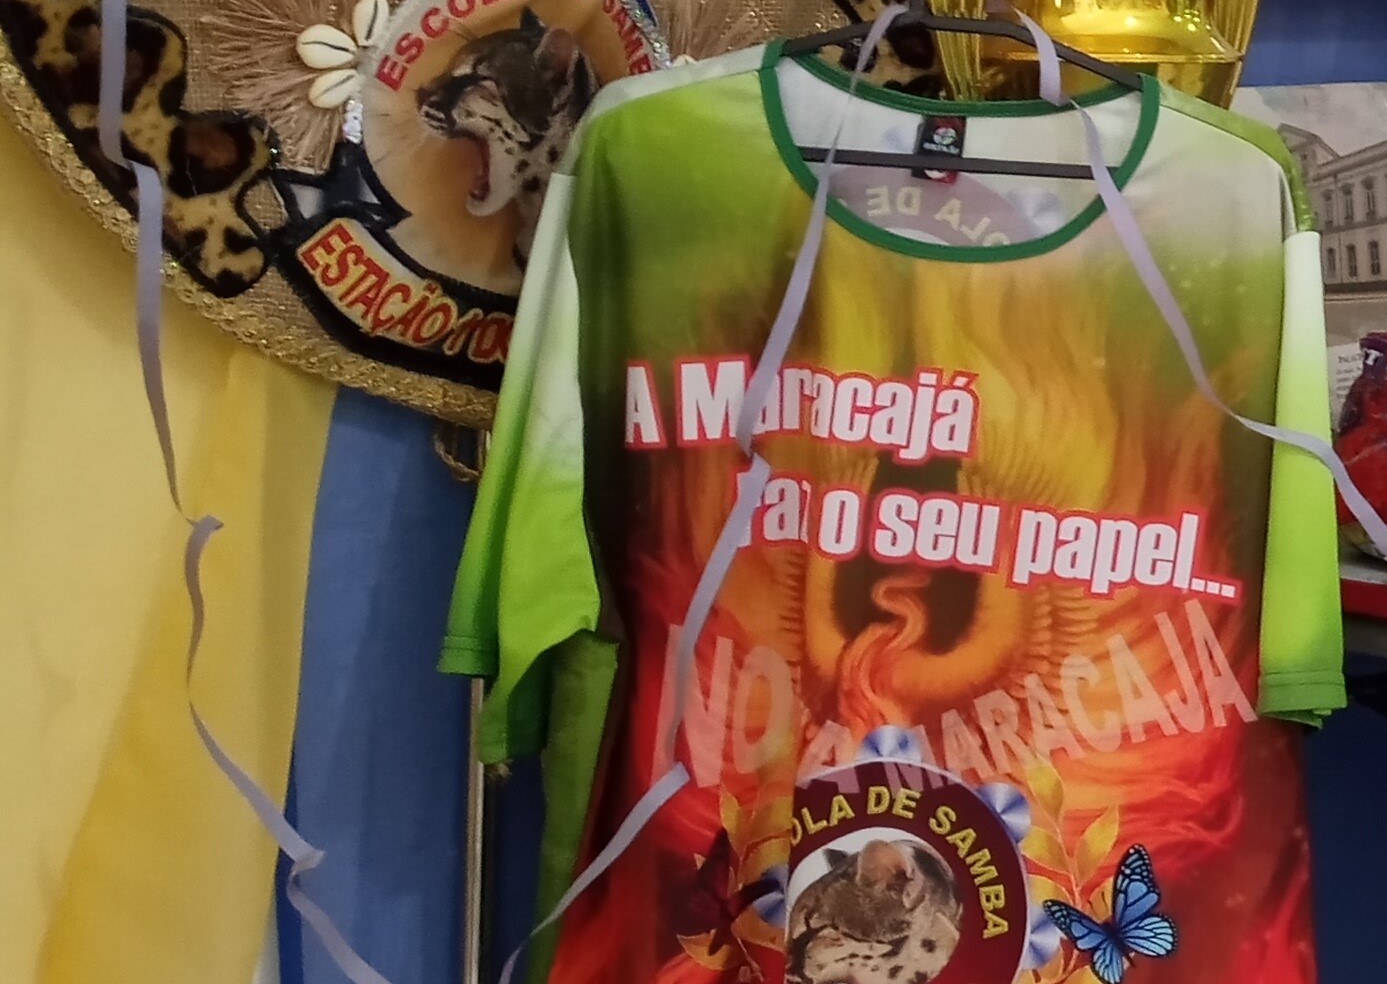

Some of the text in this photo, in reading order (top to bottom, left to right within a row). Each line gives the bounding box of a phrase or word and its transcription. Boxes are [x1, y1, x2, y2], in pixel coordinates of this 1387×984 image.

[300, 223, 455, 347] ESTAÇÃO
[626, 365, 660, 444] A
[822, 490, 860, 556] o
[876, 493, 1000, 567] seu
[1013, 509, 1237, 598] papel...
[867, 785, 921, 819] DE
[929, 806, 1009, 940] SAMBA
